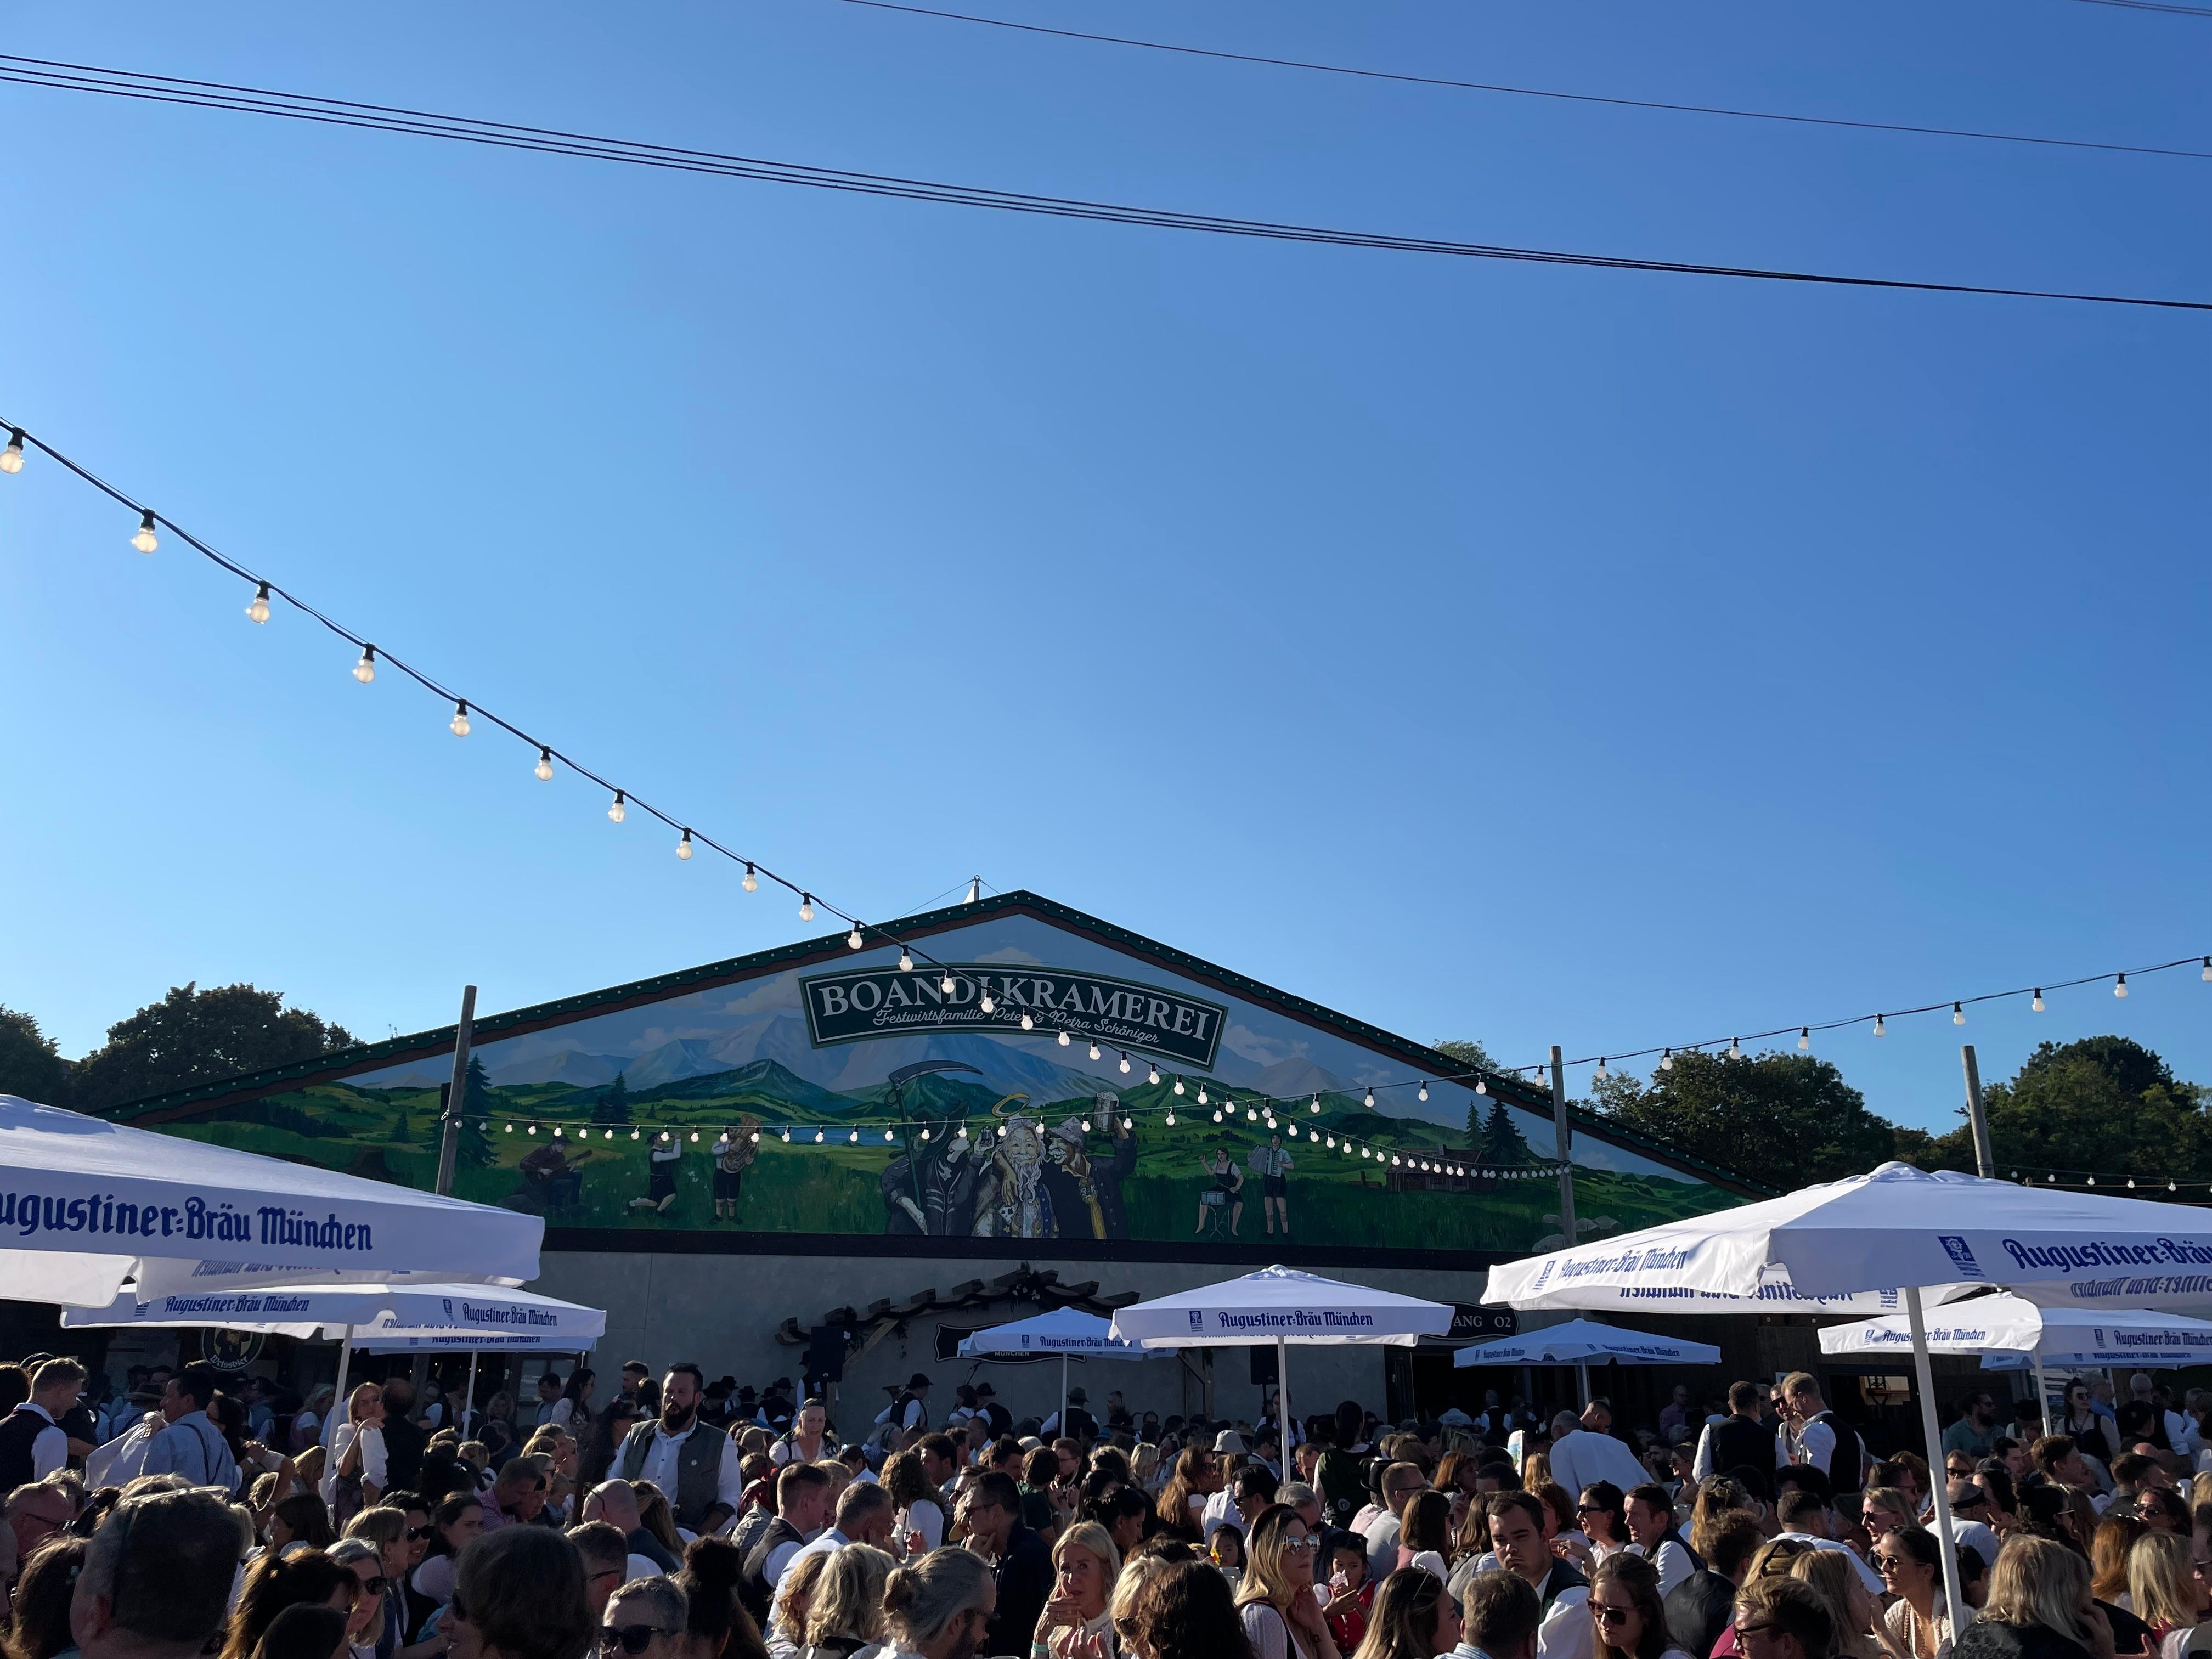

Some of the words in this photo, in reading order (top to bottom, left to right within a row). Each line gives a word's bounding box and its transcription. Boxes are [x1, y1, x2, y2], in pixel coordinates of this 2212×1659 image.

[818, 976, 1209, 1041] BOANDLKRAMEREI
[873, 1008, 985, 1025] Festwirtsfamilie
[1035, 1012, 1045, 1023] &
[1049, 1010, 1092, 1029] Petra
[1094, 1018, 1160, 1043] Schöniger
[258, 1206, 373, 1251] München
[1640, 1246, 1688, 1272] München
[262, 1295, 310, 1313] München
[528, 1309, 558, 1327] München
[1323, 1311, 1373, 1326] München
[1953, 1328, 1986, 1341] München
[210, 1354, 248, 1368] Weissbier
